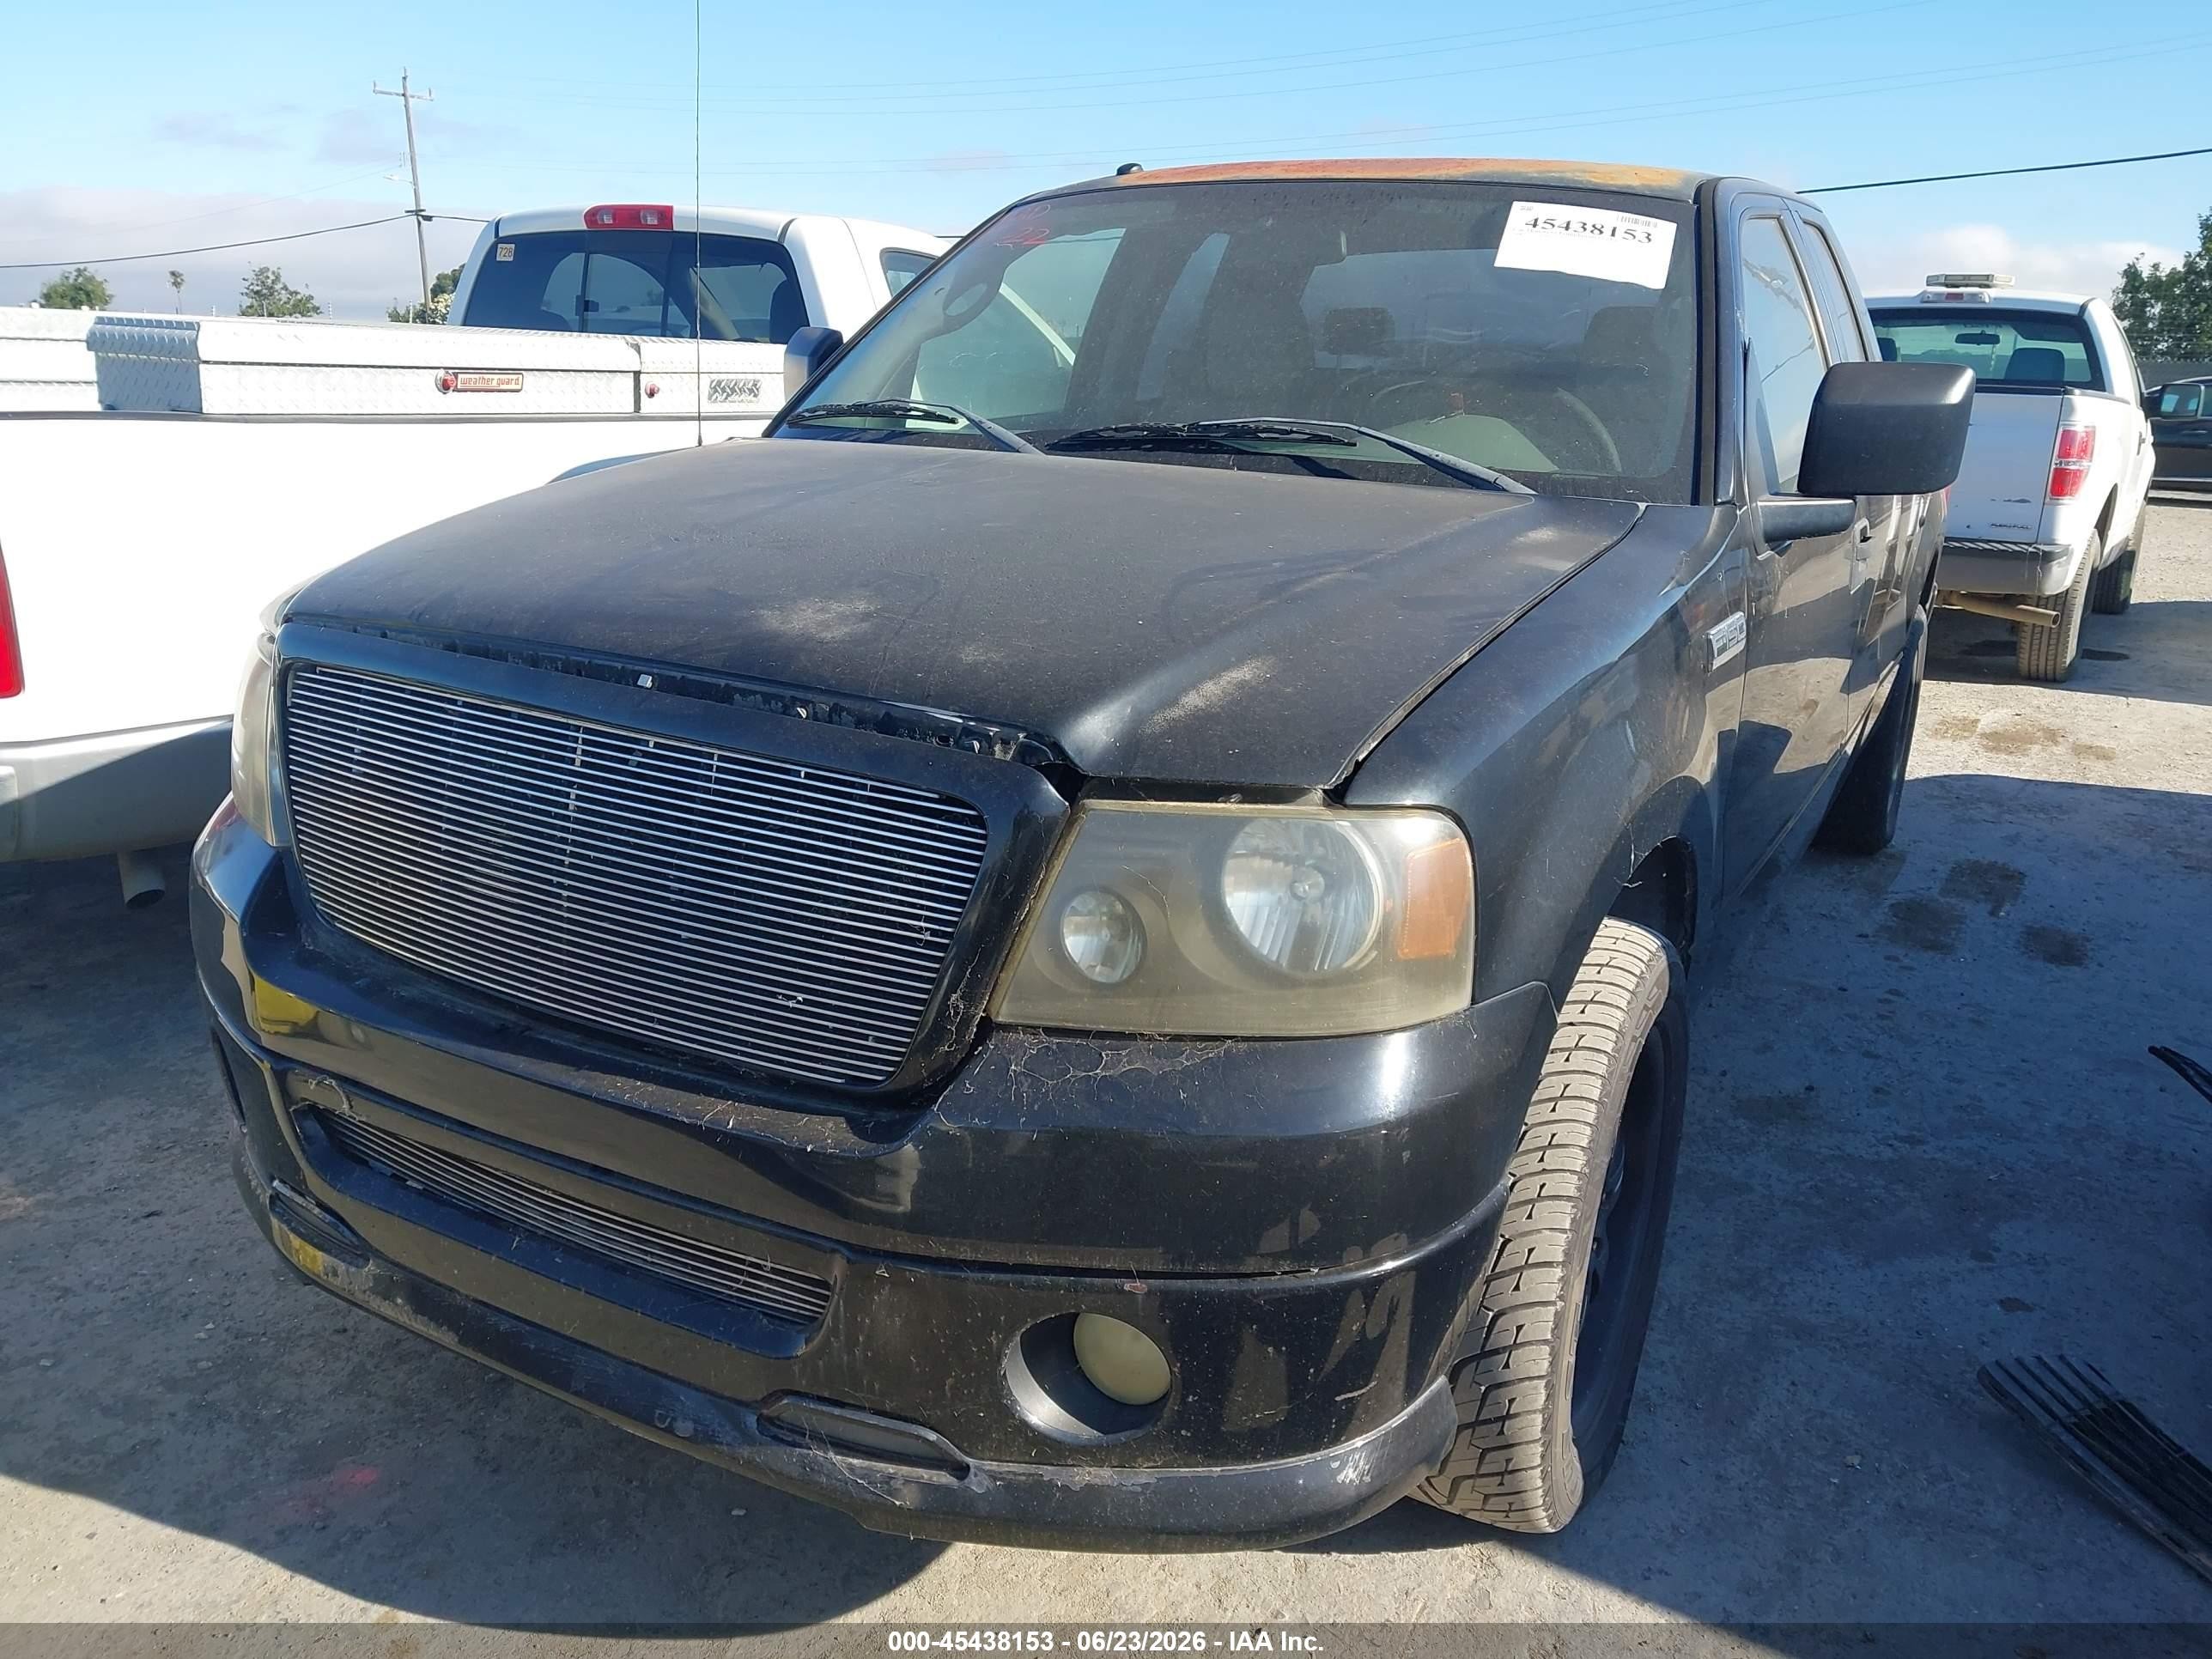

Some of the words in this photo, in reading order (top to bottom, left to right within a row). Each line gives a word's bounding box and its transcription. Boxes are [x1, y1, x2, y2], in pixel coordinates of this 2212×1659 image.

[1524, 216, 1653, 244] 45438153
[499, 246, 514, 258] 728
[459, 376, 495, 386] weather
